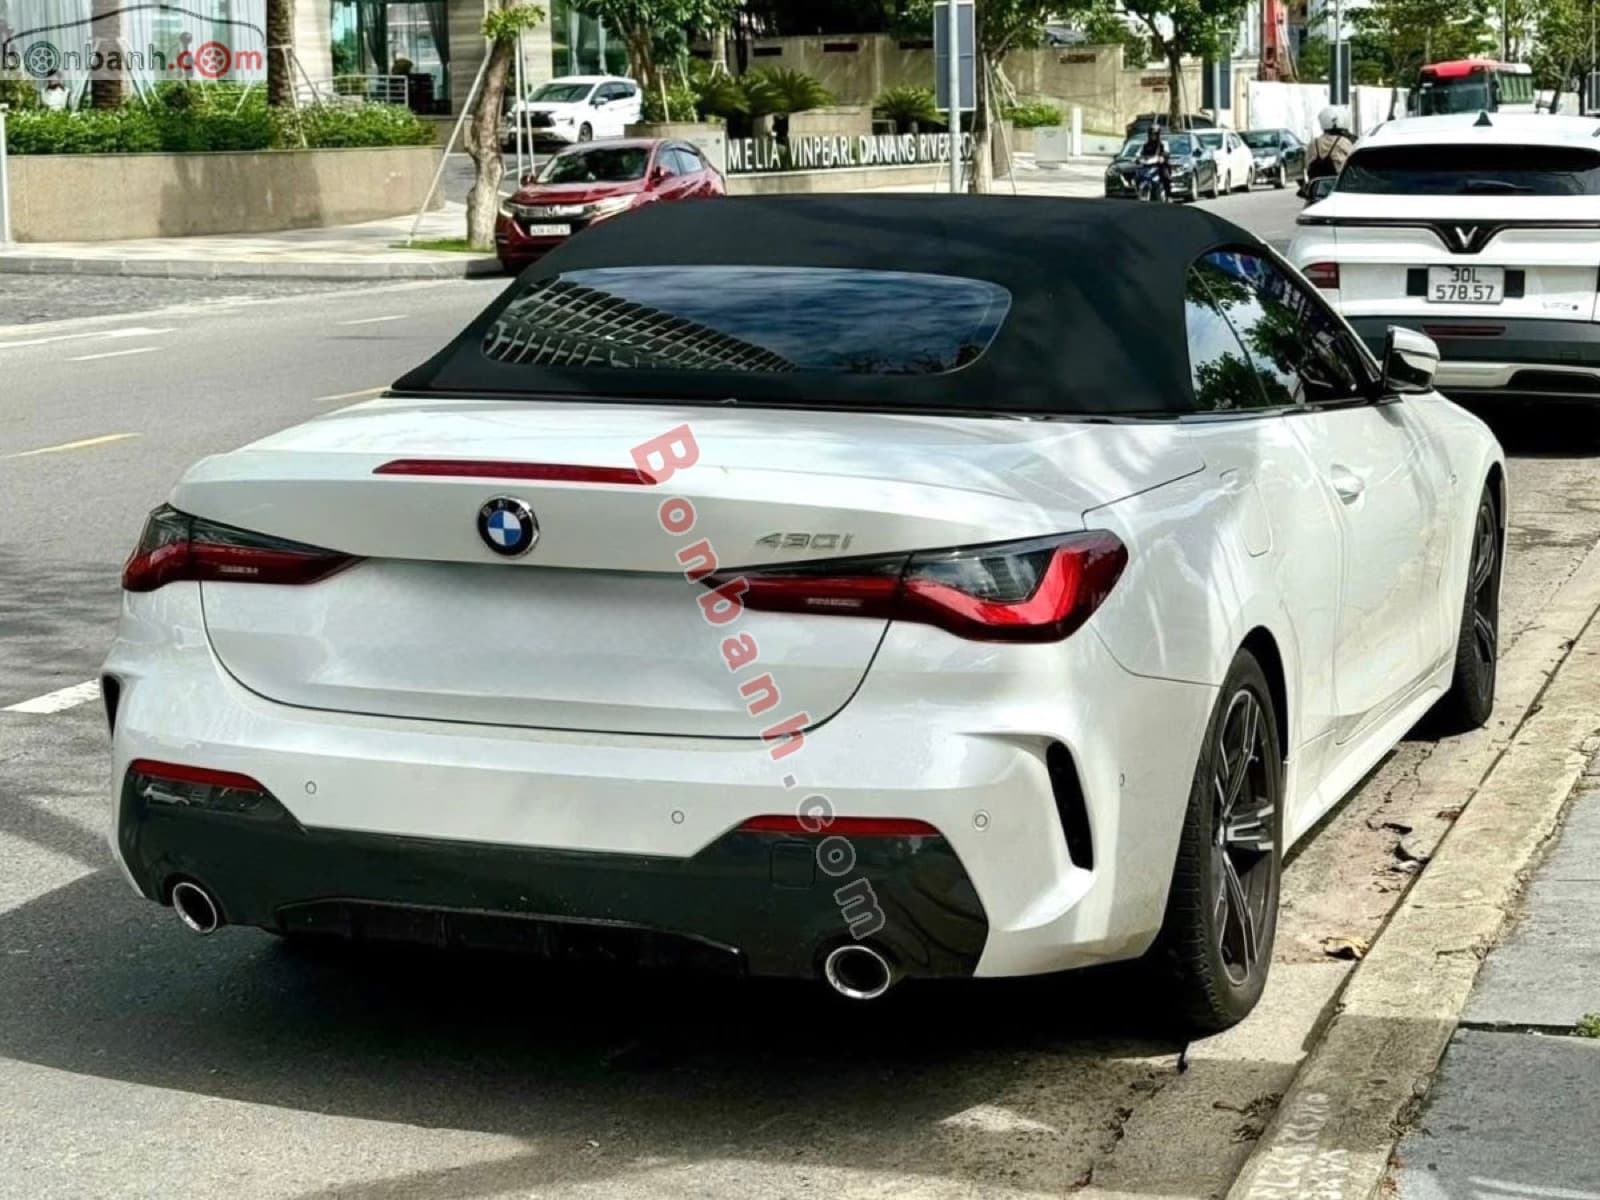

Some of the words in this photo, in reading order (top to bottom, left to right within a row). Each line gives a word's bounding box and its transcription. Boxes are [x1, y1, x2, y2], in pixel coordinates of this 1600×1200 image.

[788, 136, 855, 167] VINPEARL
[859, 133, 916, 163] DANANG
[1450, 267, 1481, 284] 30L
[1435, 284, 1495, 301] 578.57
